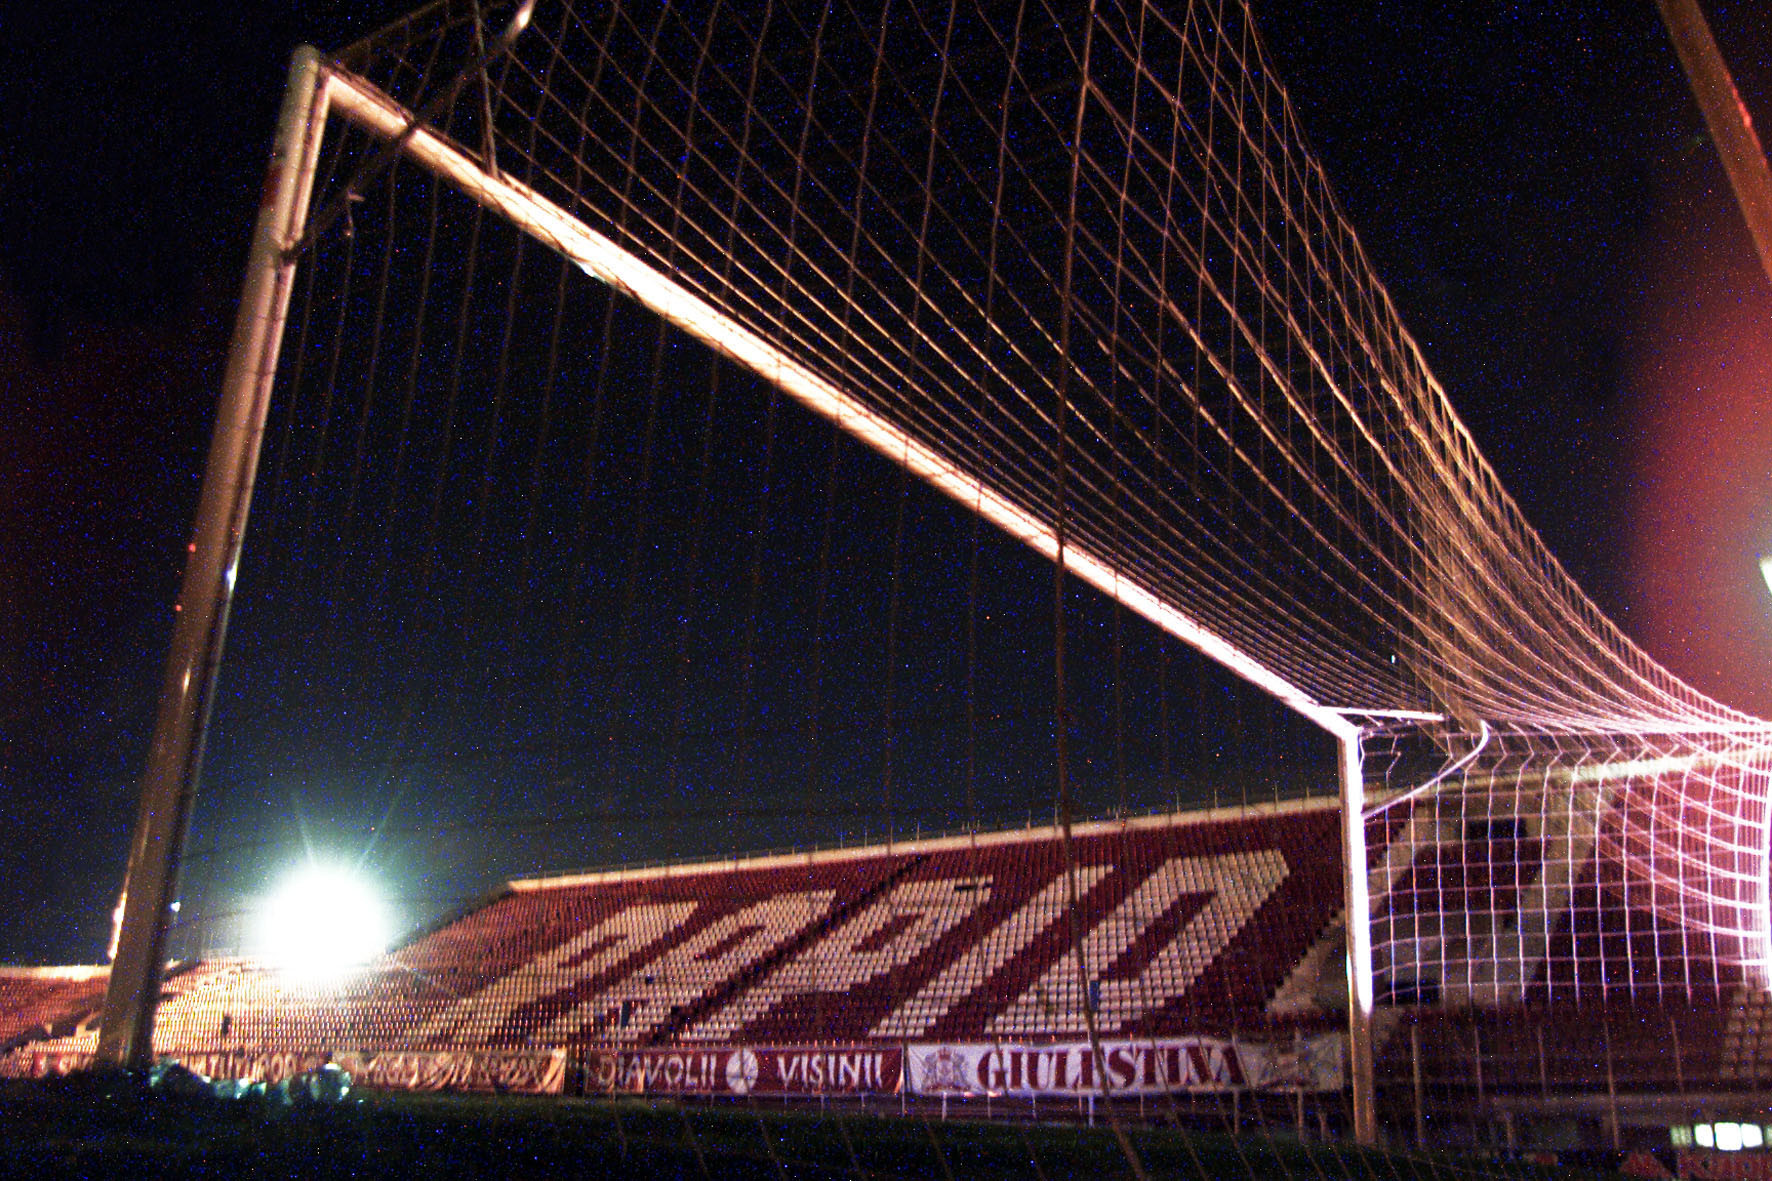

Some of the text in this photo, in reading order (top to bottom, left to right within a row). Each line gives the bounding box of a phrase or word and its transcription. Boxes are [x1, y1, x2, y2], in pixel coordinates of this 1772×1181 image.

[405, 849, 1291, 1042] RAPID
[598, 1054, 886, 1089] DIAVOLII VISINII
